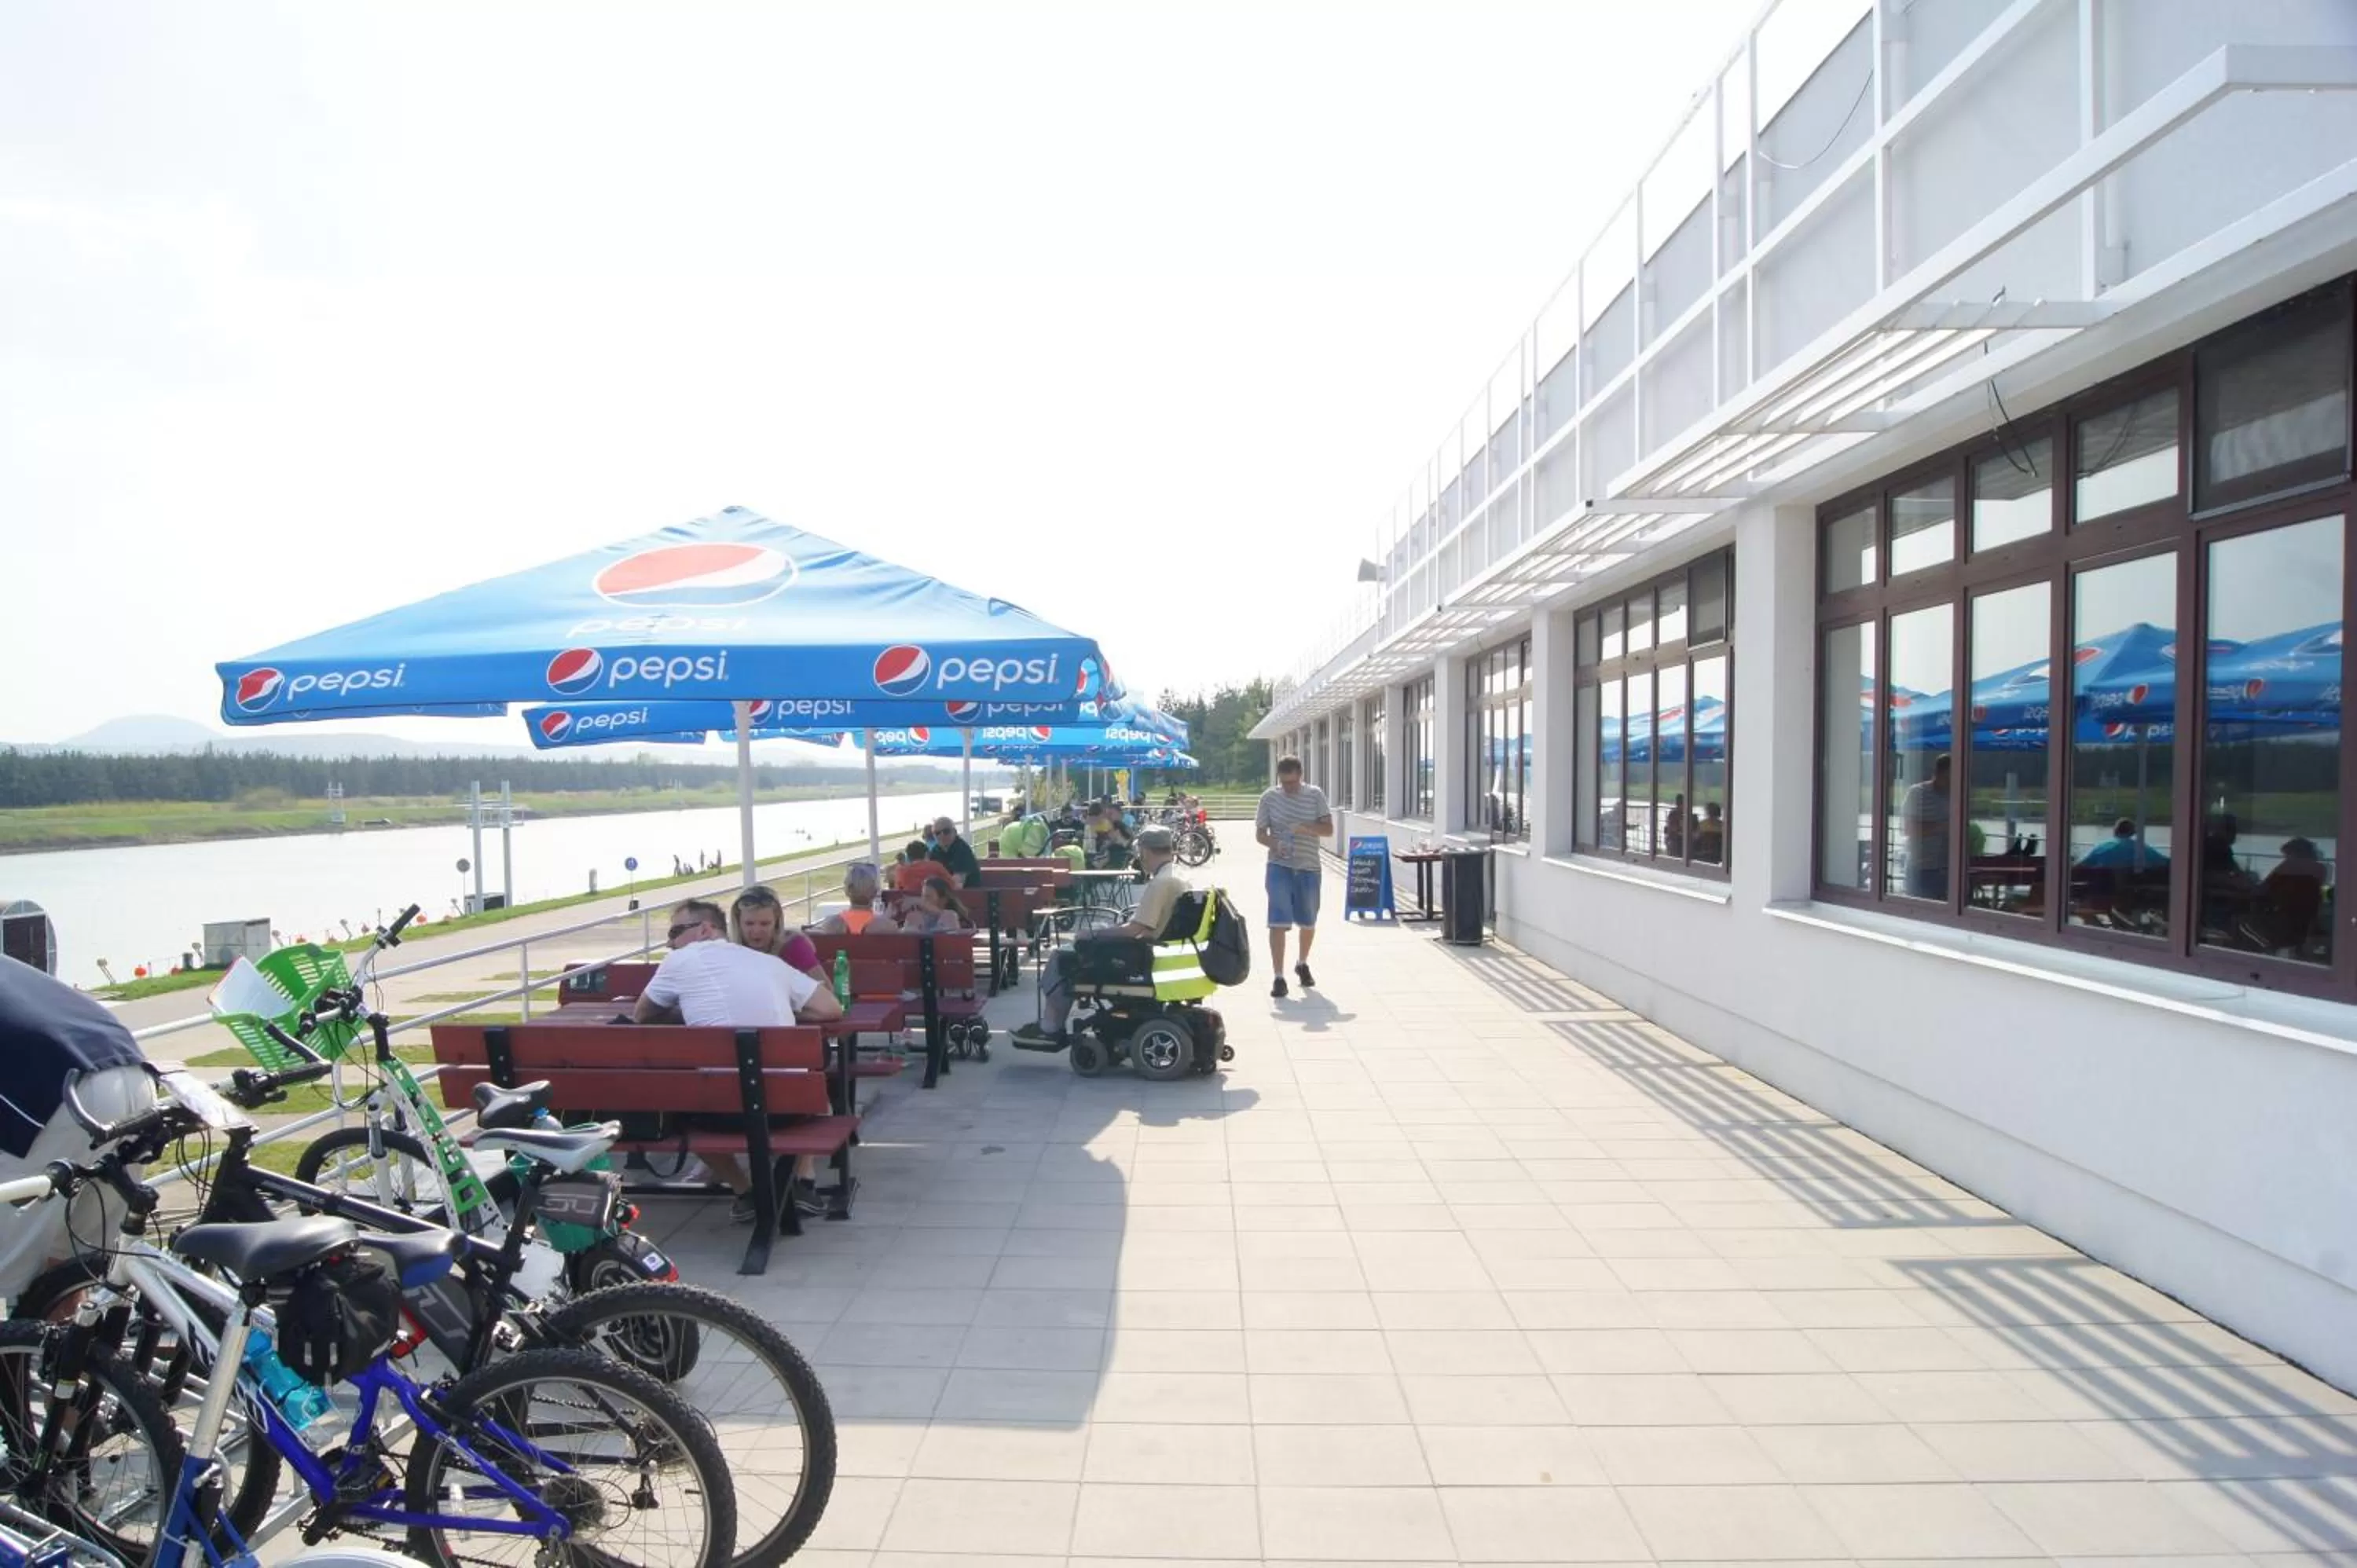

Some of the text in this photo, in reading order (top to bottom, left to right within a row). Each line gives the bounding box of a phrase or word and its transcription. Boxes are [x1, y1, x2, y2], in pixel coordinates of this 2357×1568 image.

[287, 663, 406, 701] pepsi
[609, 650, 728, 688] pepsi
[937, 653, 1059, 691] pepsi
[575, 707, 648, 734] pepsi
[778, 700, 852, 720] pepsi
